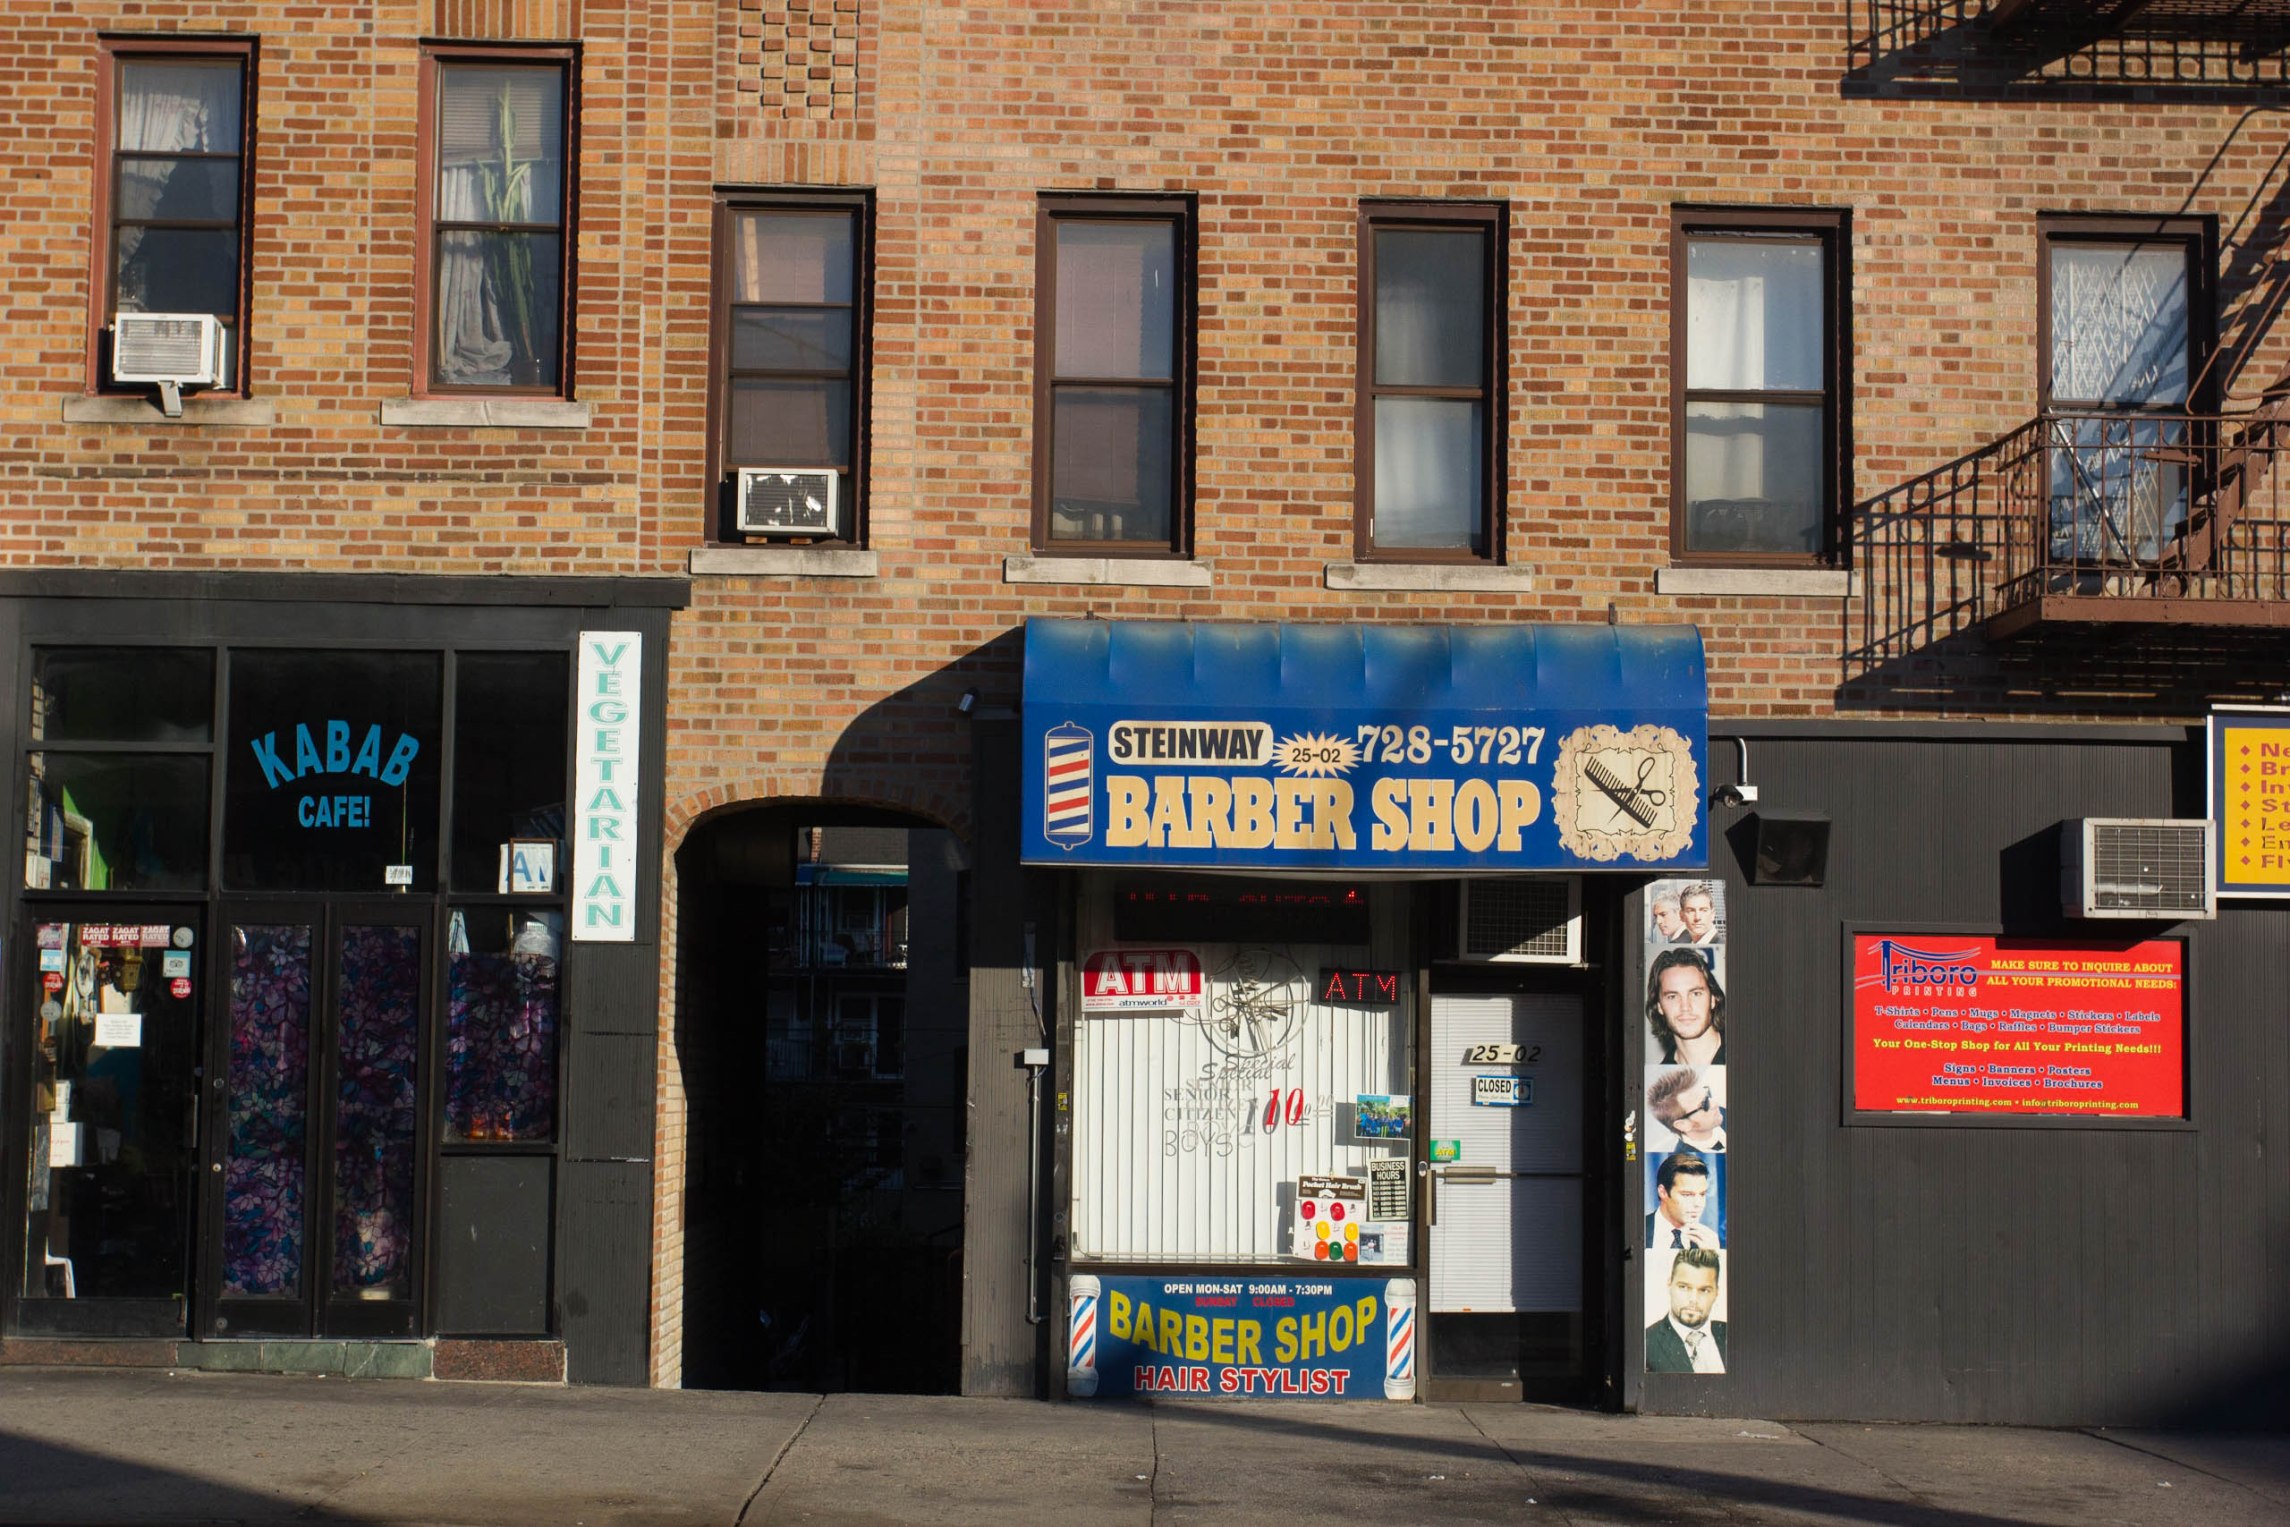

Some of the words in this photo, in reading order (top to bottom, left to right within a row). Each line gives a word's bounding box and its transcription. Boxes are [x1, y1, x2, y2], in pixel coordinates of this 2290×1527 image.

[1114, 726, 1264, 760] STEINWAY
[1357, 725, 1546, 765] 728-5727
[251, 720, 420, 790] KABAB
[1292, 748, 1341, 763] 25-02
[585, 642, 630, 928] VEGETARIAN
[298, 796, 370, 828] CAFE!
[1106, 775, 1356, 850] BARBER
[1372, 778, 1541, 852] SHOP
[1095, 952, 1192, 994] ATM
[1991, 960, 2025, 970] MAKE
[2028, 961, 2060, 970] SURE
[2062, 962, 2079, 970] TO
[2082, 962, 2130, 972] INQUIRE
[2134, 964, 2174, 973] ABOUT
[1325, 972, 1396, 1000] ATM
[1986, 976, 2009, 985] ALL
[2012, 977, 2044, 986] YOUR
[2048, 978, 2132, 988] PROMOTIONAL
[1892, 986, 1977, 996] PRINTING
[1118, 998, 1168, 1007] atmworld
[1875, 1006, 1920, 1016] T-Shirts
[1930, 1008, 1958, 1017] Pens
[1968, 1008, 1998, 1019] Mugs
[2010, 1010, 2056, 1020] Magnets
[2068, 1010, 2114, 1020] Stickers
[2124, 1012, 2160, 1022] Labels
[1894, 1019, 1950, 1030] Calendars
[1961, 1022, 1987, 1033] Bags
[1998, 1022, 2036, 1032] Raffles
[2048, 1023, 2092, 1034] Bumper
[2094, 1024, 2142, 1034] Stickers
[1472, 1045, 1542, 1062] 25-02
[1873, 1038, 1900, 1048] Your
[1904, 1039, 1958, 1051] One-Stop
[1961, 1040, 1990, 1052] Shop
[1994, 1041, 2010, 1050] for
[2014, 1042, 2030, 1050] All
[2033, 1042, 2060, 1052] Your
[2064, 1042, 2112, 1054] Printing
[2116, 1044, 2162, 1054] Needs!!!
[1944, 1063, 1976, 1074] Signs
[1988, 1065, 2036, 1074] Banners
[2048, 1066, 2092, 1076] Posters
[1477, 1079, 1512, 1093] CLOSED
[1932, 1076, 1970, 1086] Menus
[1982, 1078, 2032, 1087] Invoices
[2044, 1078, 2104, 1088] Brochures
[1371, 1162, 1405, 1171] BUSINESS
[1376, 1171, 1400, 1180] HOURS
[1164, 1284, 1194, 1294] OPEN
[1196, 1284, 1242, 1294] MON-SAT
[1248, 1284, 1286, 1295] 9:00AM
[1296, 1284, 1332, 1296] 7:30PM
[1195, 1297, 1238, 1307] SUNDAY
[1253, 1297, 1295, 1307] CLOSED
[1110, 1289, 1262, 1364] BARBER
[1275, 1295, 1378, 1364] SHOP
[1134, 1366, 1210, 1392] HAIR
[1220, 1368, 1350, 1394] STYLIST
